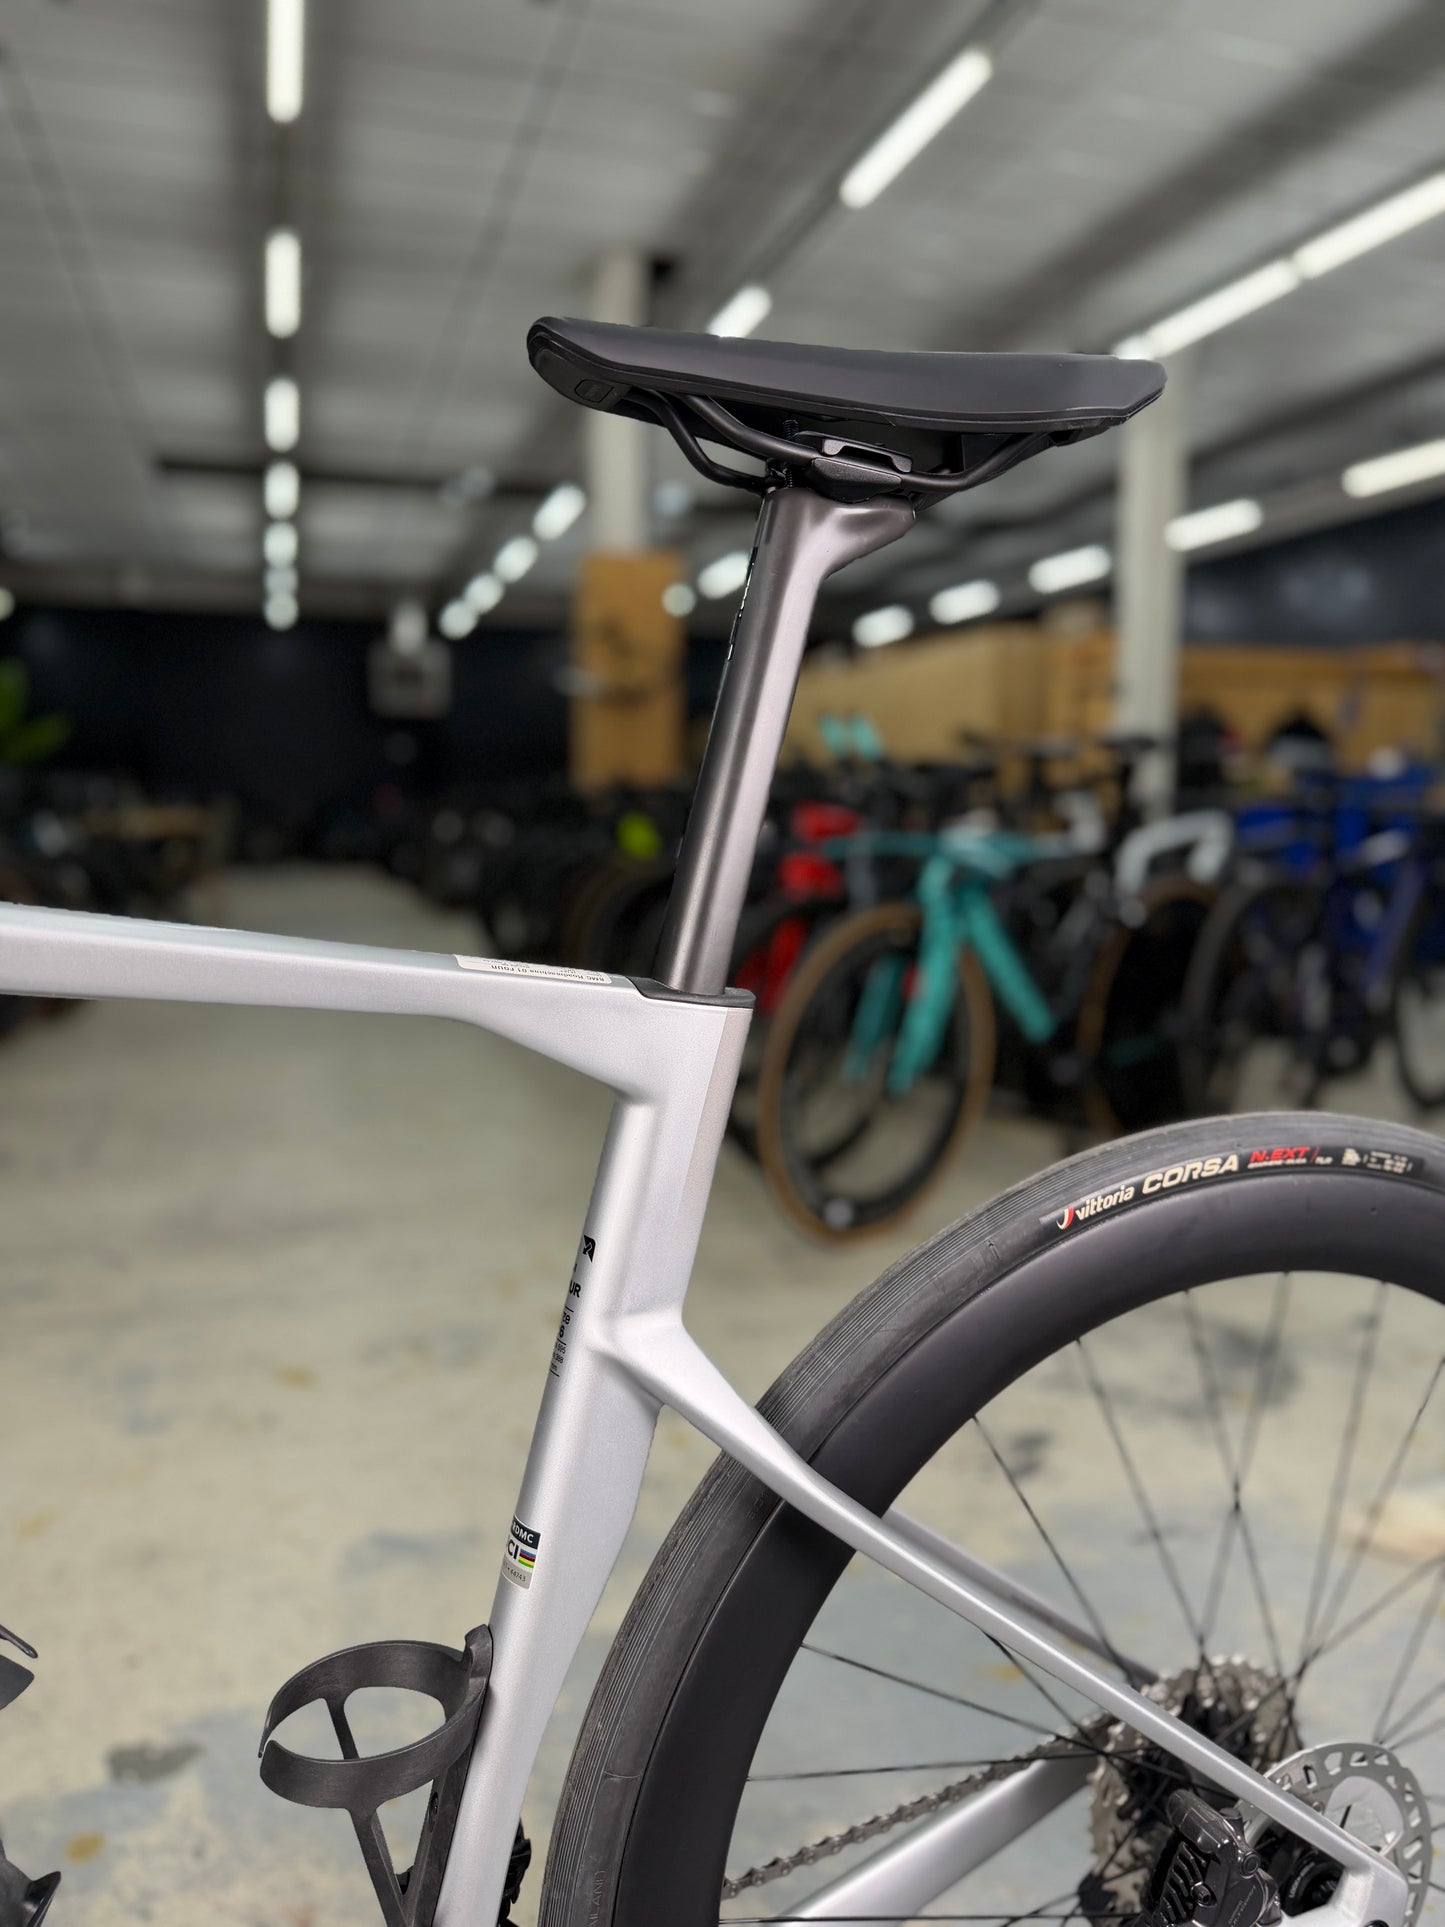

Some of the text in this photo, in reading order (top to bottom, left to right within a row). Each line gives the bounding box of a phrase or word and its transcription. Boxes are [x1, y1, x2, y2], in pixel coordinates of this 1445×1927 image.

[1075, 1184, 1135, 1221] vittoria
[1142, 1153, 1239, 1195] CORSA
[1249, 1146, 1311, 1163] N.EXT
